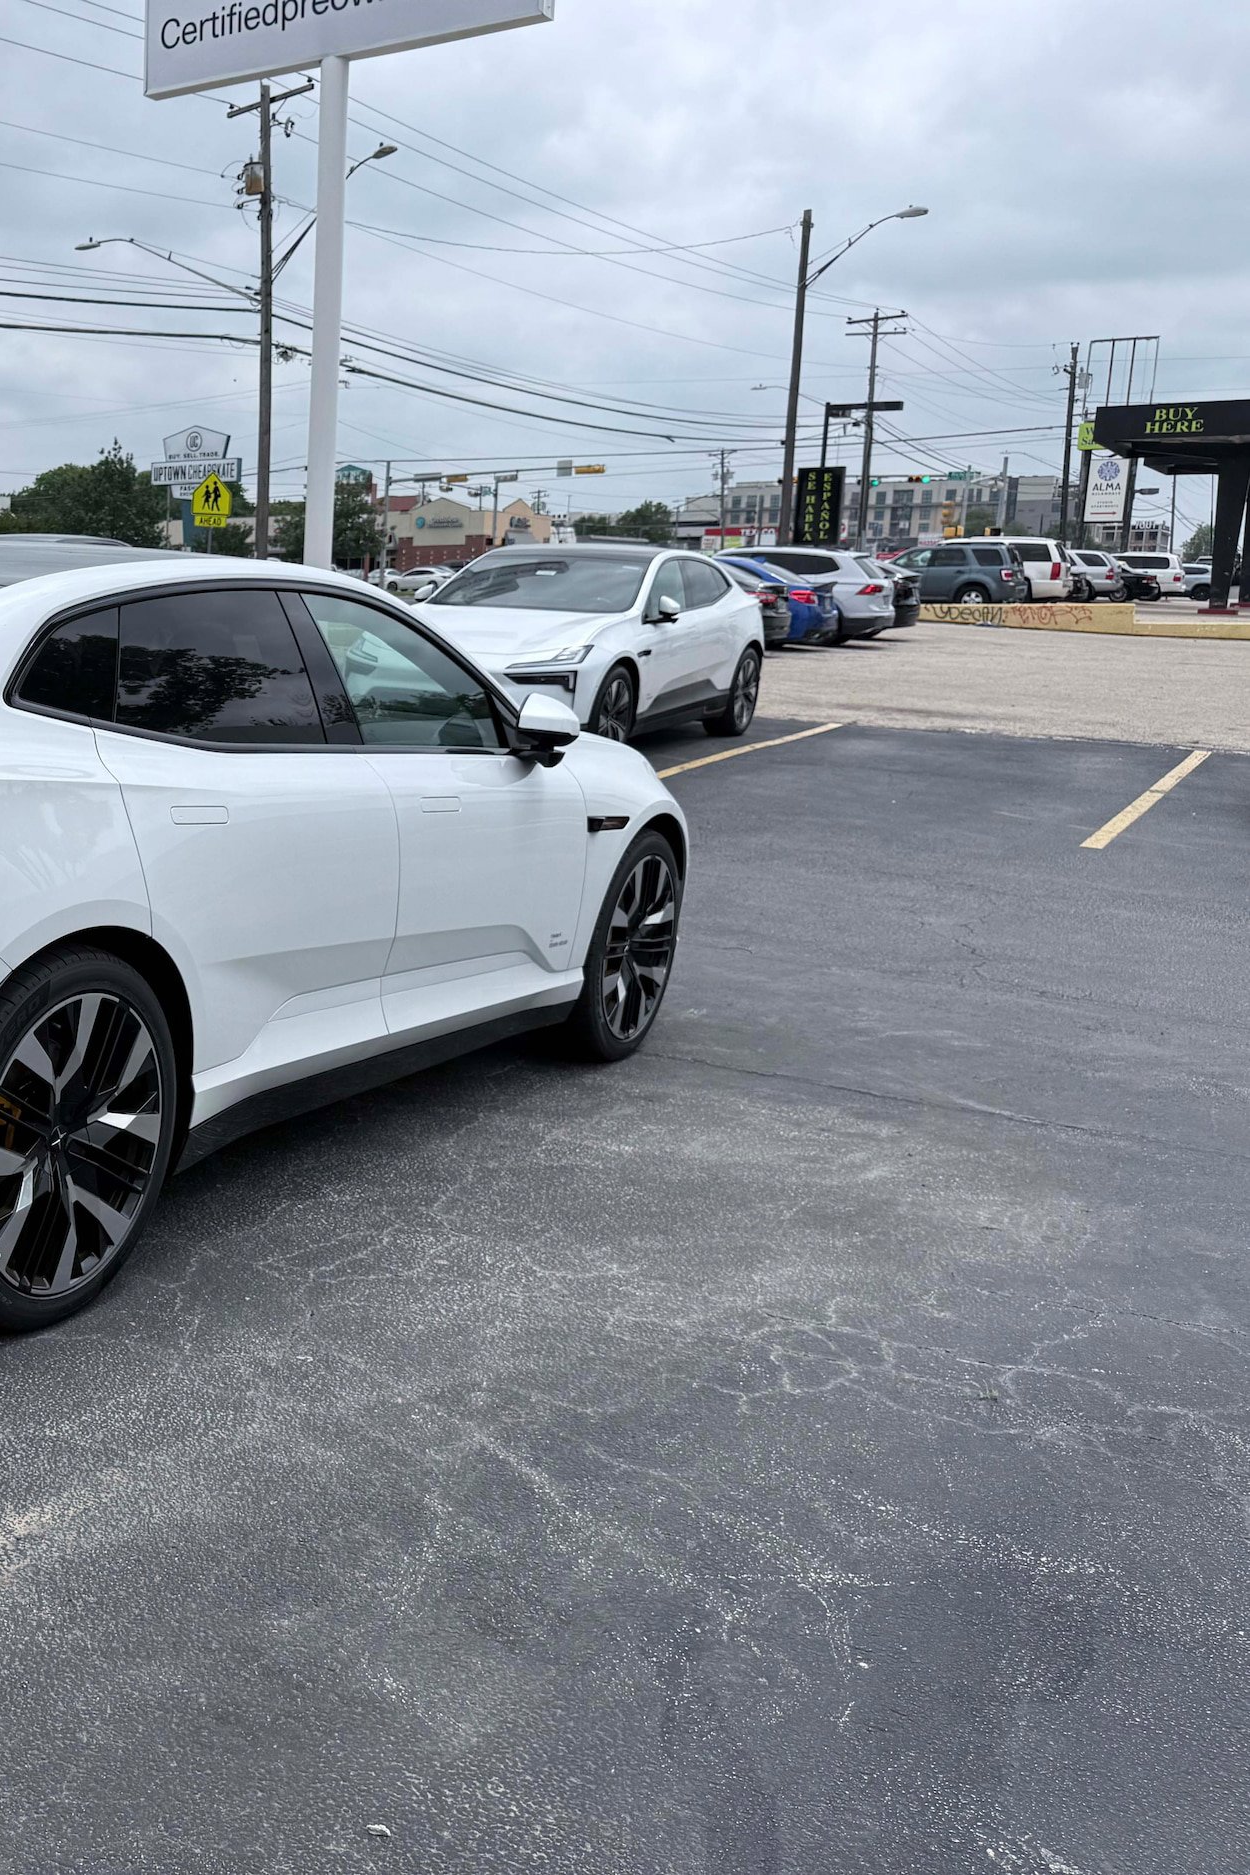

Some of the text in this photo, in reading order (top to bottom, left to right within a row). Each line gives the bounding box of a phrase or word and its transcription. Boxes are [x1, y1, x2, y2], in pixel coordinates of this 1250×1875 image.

[161, 0, 383, 49] Certifiedpre
[1154, 406, 1199, 421] BUY
[1145, 418, 1205, 434] HERE
[153, 465, 187, 482] UPTOWN
[1092, 482, 1122, 492] ALMA
[802, 471, 817, 542] SE HABLA
[819, 472, 833, 540] ESPAÑOL
[199, 516, 222, 526] AHEAD
[741, 527, 777, 536] TEXCO
